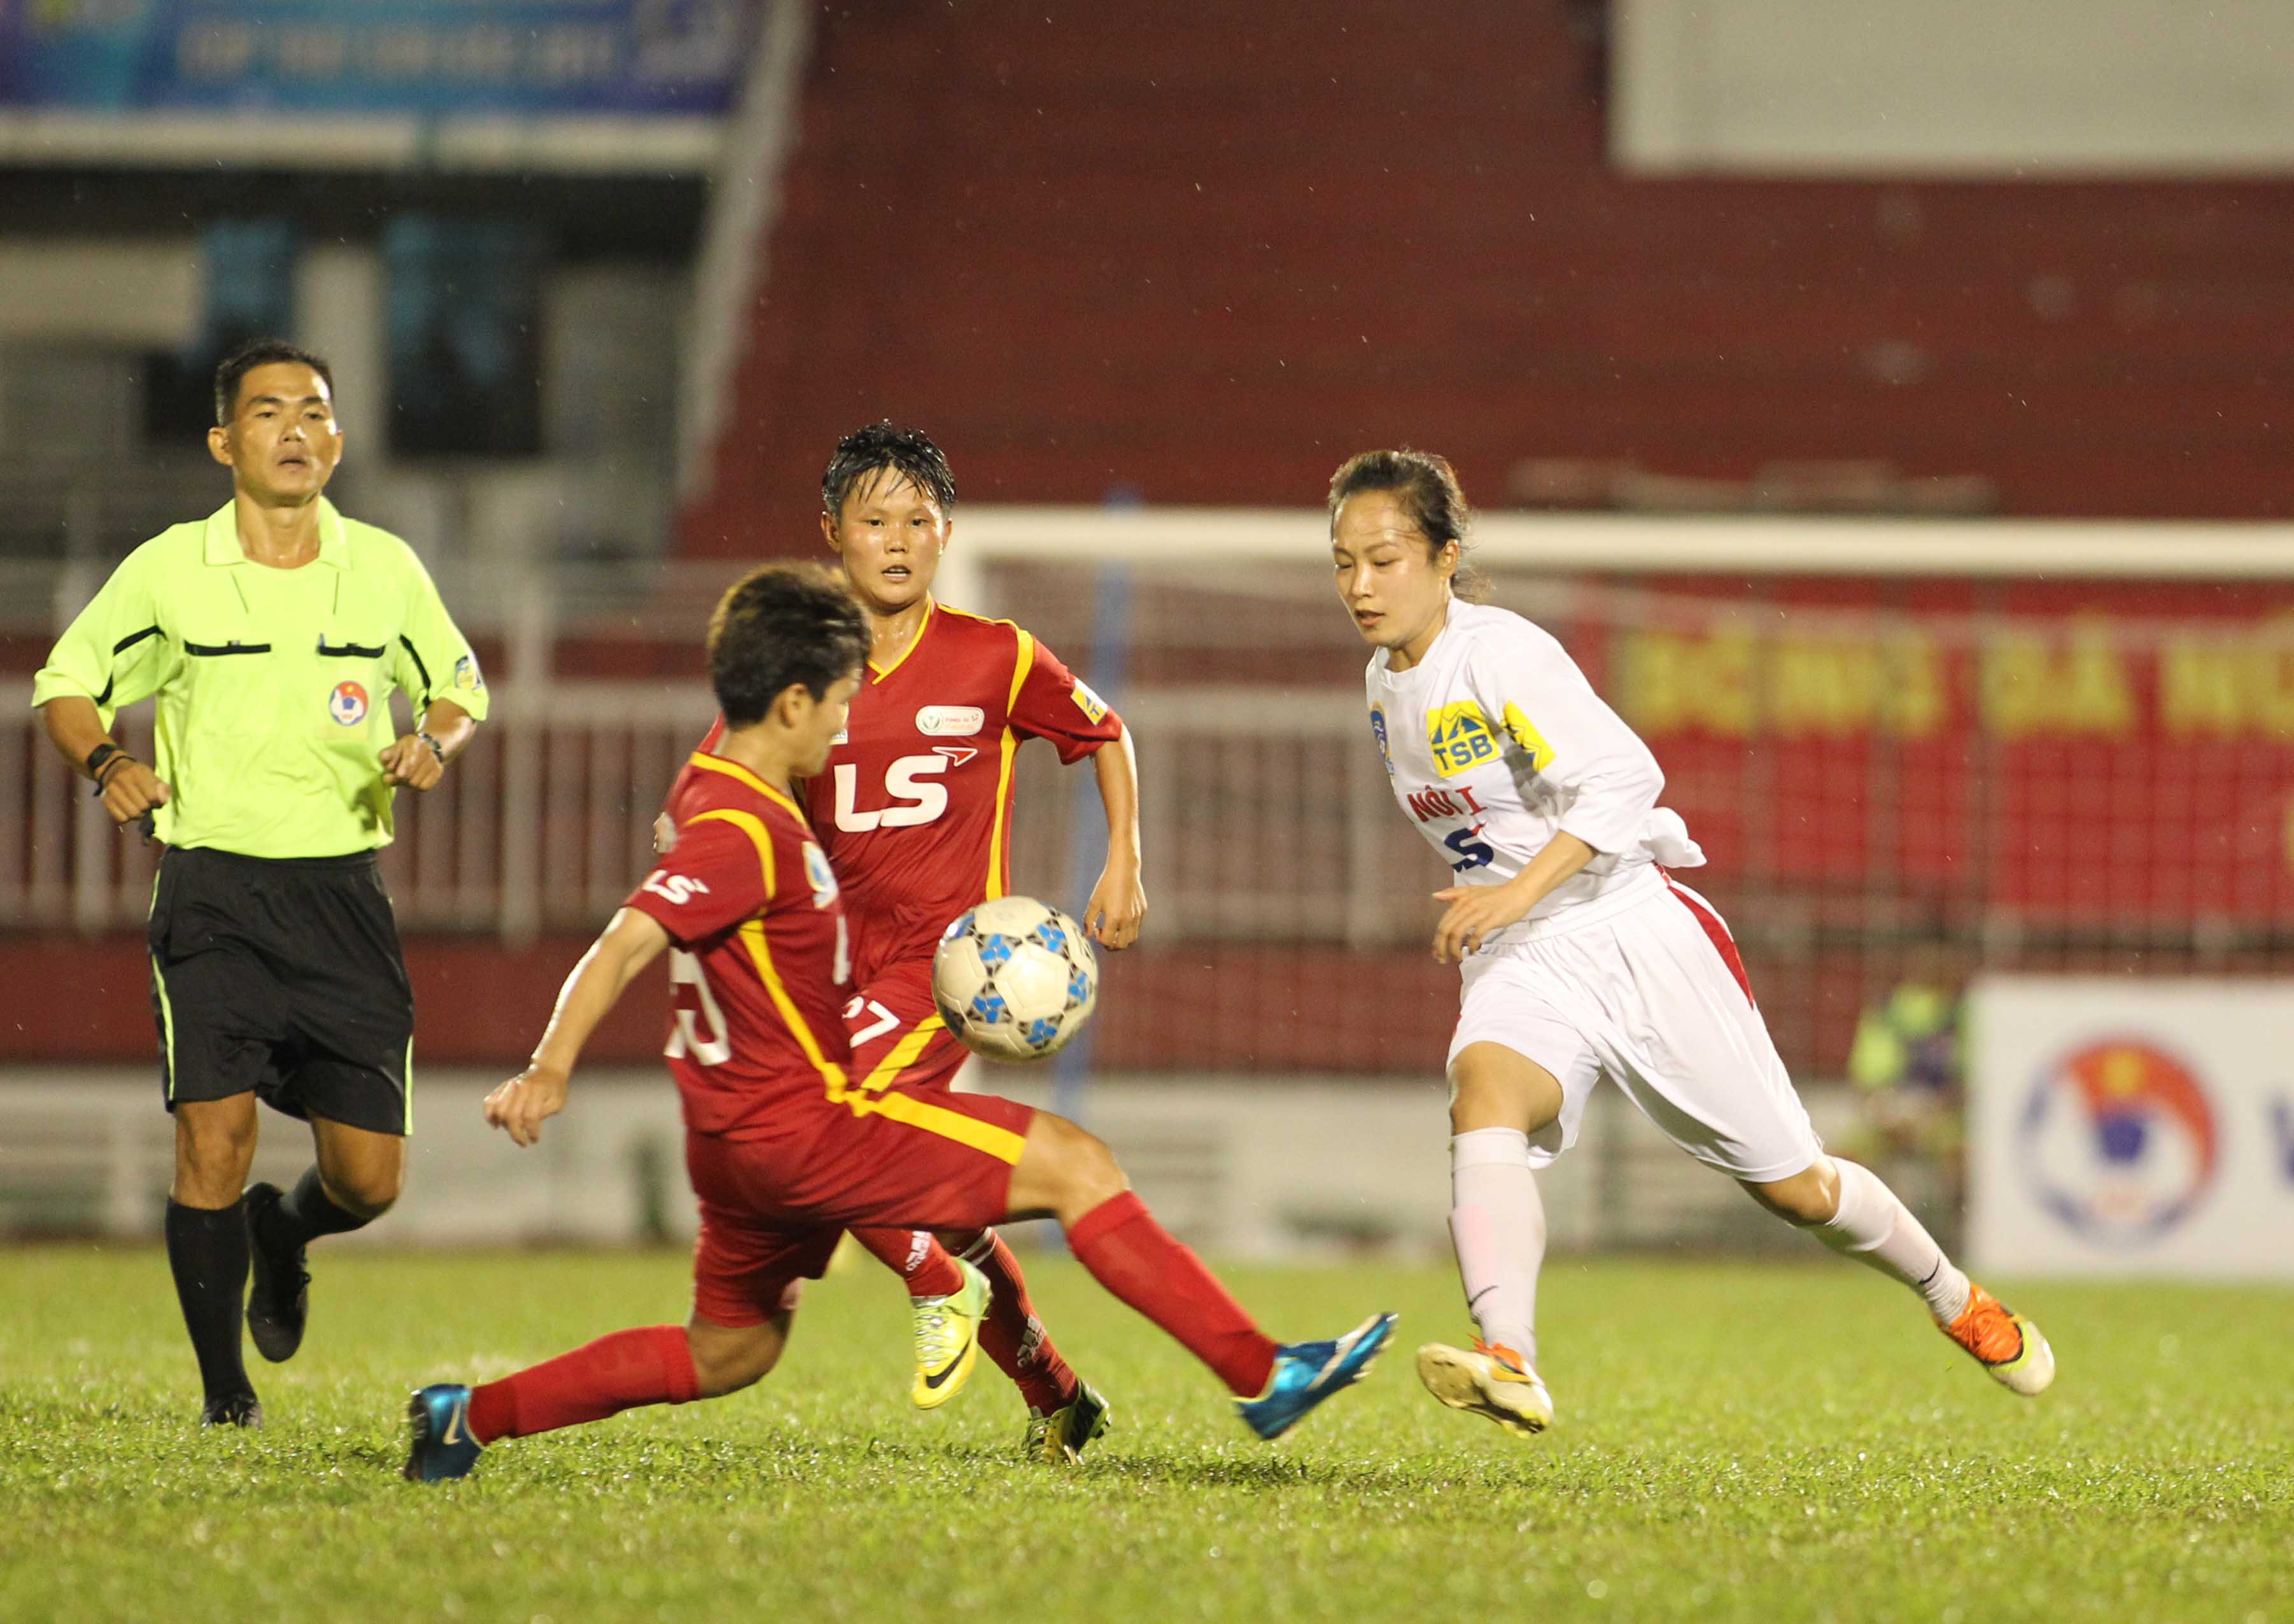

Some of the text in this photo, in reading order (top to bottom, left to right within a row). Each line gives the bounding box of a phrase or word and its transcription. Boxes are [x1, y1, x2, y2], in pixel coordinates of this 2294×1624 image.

[1434, 734, 1493, 771] TSB
[834, 755, 948, 833] LS
[642, 869, 696, 905] LS
